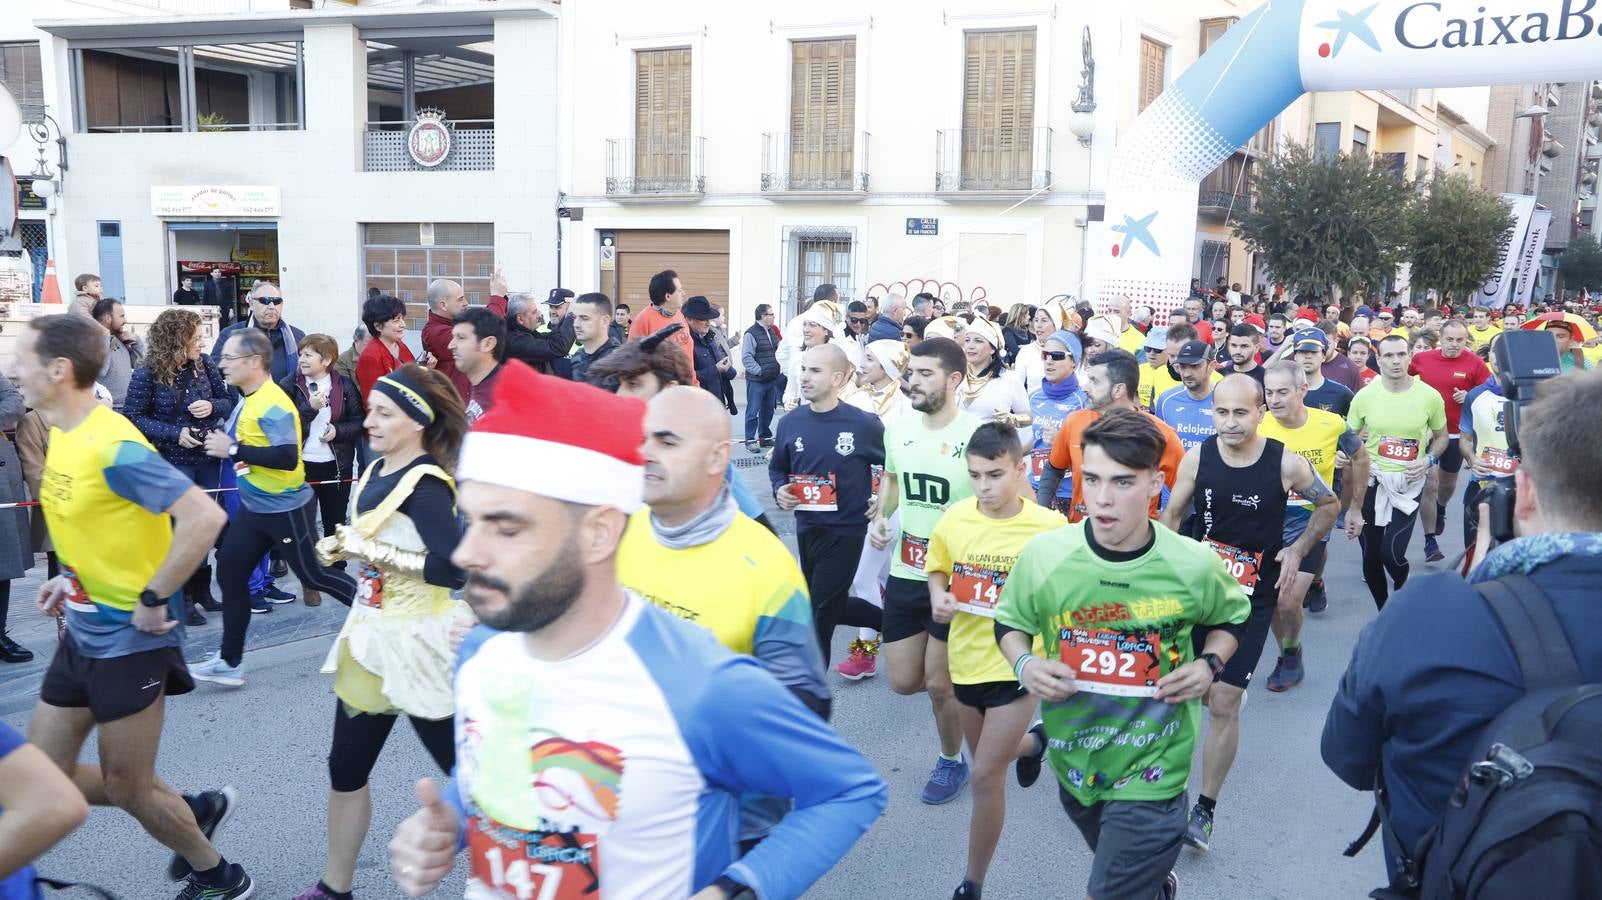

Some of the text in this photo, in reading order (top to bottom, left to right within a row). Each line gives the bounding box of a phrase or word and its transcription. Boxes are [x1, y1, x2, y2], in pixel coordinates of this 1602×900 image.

[1394, 0, 1602, 50] CaixaB
[1386, 444, 1411, 457] 385
[1489, 456, 1512, 469] 386
[803, 486, 820, 500] 95
[1204, 488, 1213, 537] SAN SILV
[973, 582, 998, 603] 14
[1061, 630, 1071, 640] VI
[1073, 629, 1089, 638] SAN
[1116, 640, 1153, 653] LORCA
[1081, 648, 1136, 678] 292
[485, 847, 564, 900] 147
